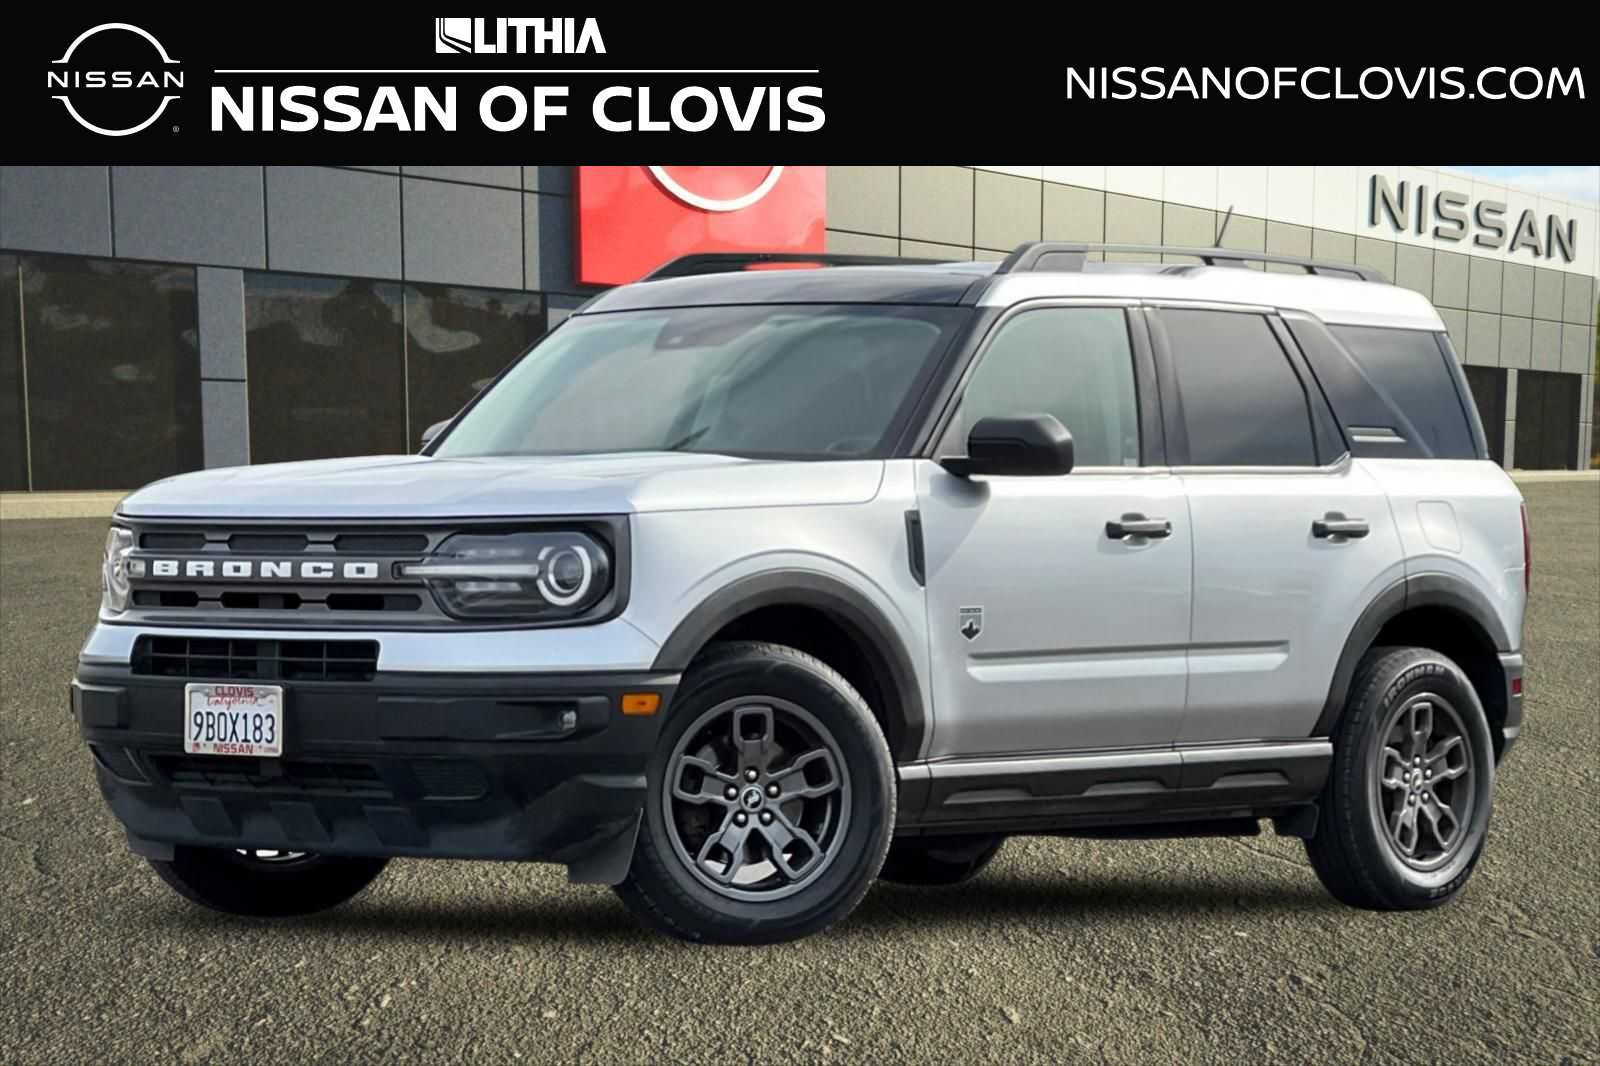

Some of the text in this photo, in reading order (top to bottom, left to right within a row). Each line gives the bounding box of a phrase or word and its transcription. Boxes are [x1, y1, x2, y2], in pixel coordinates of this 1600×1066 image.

[1369, 173, 1578, 263] NISSAN
[152, 559, 379, 579] BRONCO
[215, 686, 255, 697] CLOVIS
[213, 742, 255, 755] NISSAN
